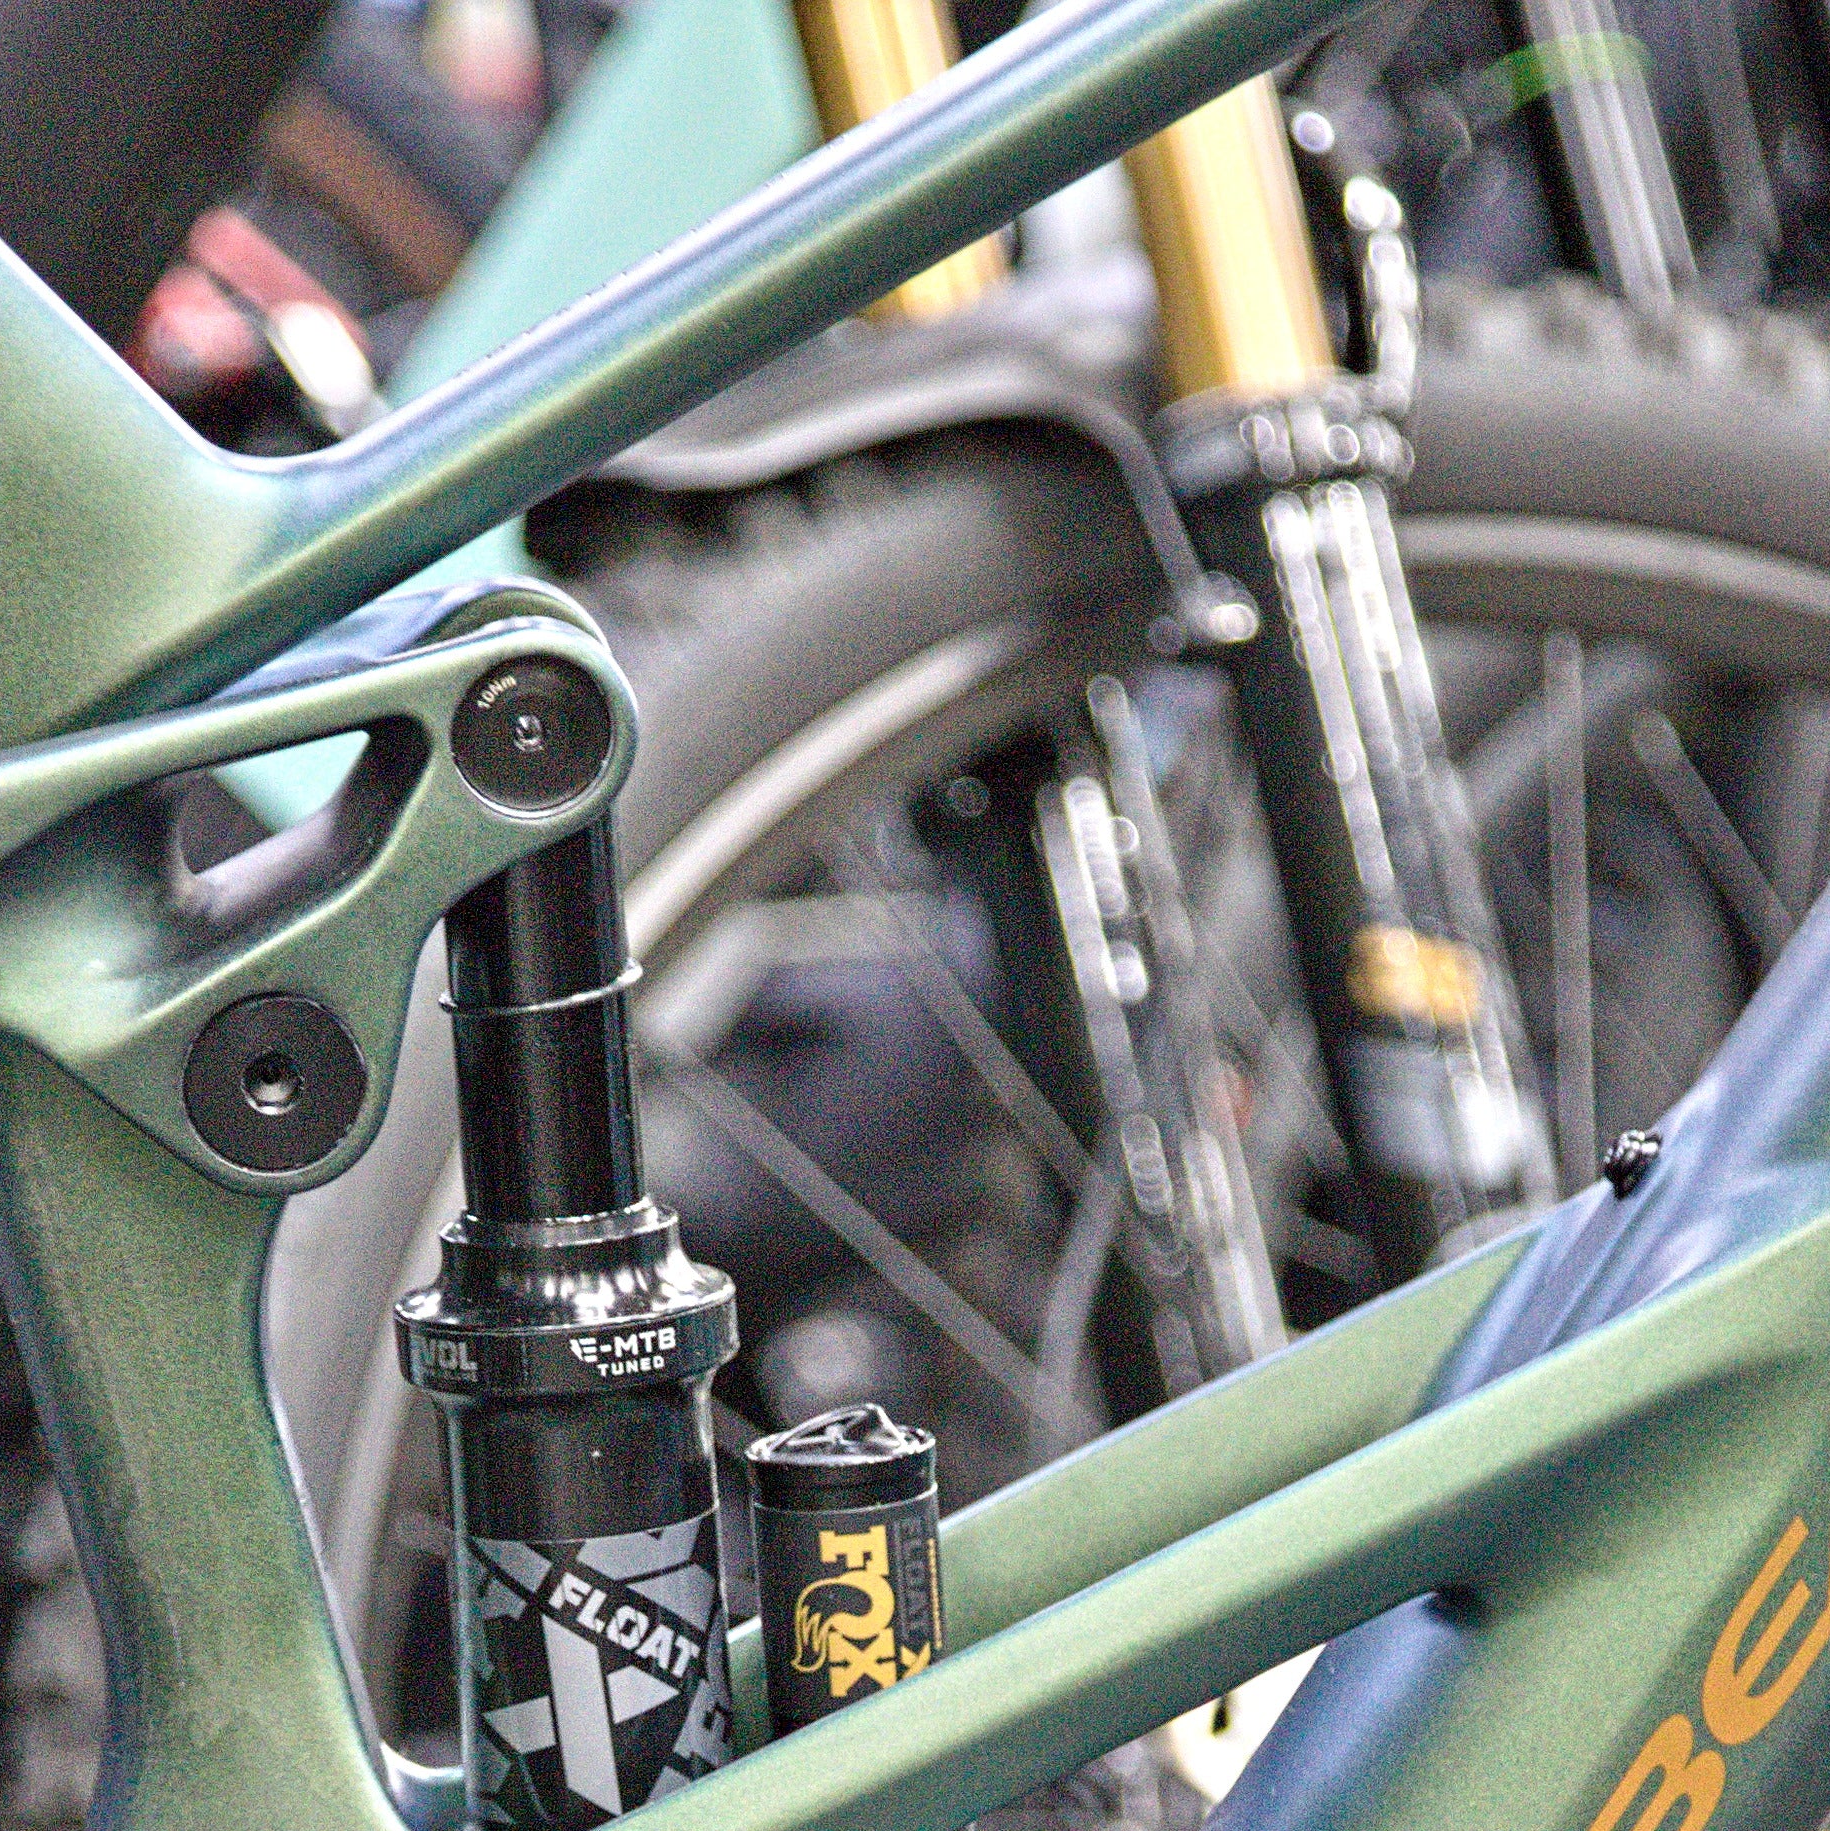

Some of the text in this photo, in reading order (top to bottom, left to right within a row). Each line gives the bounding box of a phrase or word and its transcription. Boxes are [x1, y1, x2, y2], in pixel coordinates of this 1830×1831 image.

[476, 675, 519, 710] 10Nm
[597, 1355, 666, 1377] TUNED
[549, 1573, 702, 1678] FLOAT
[793, 1525, 897, 1698] FOX
